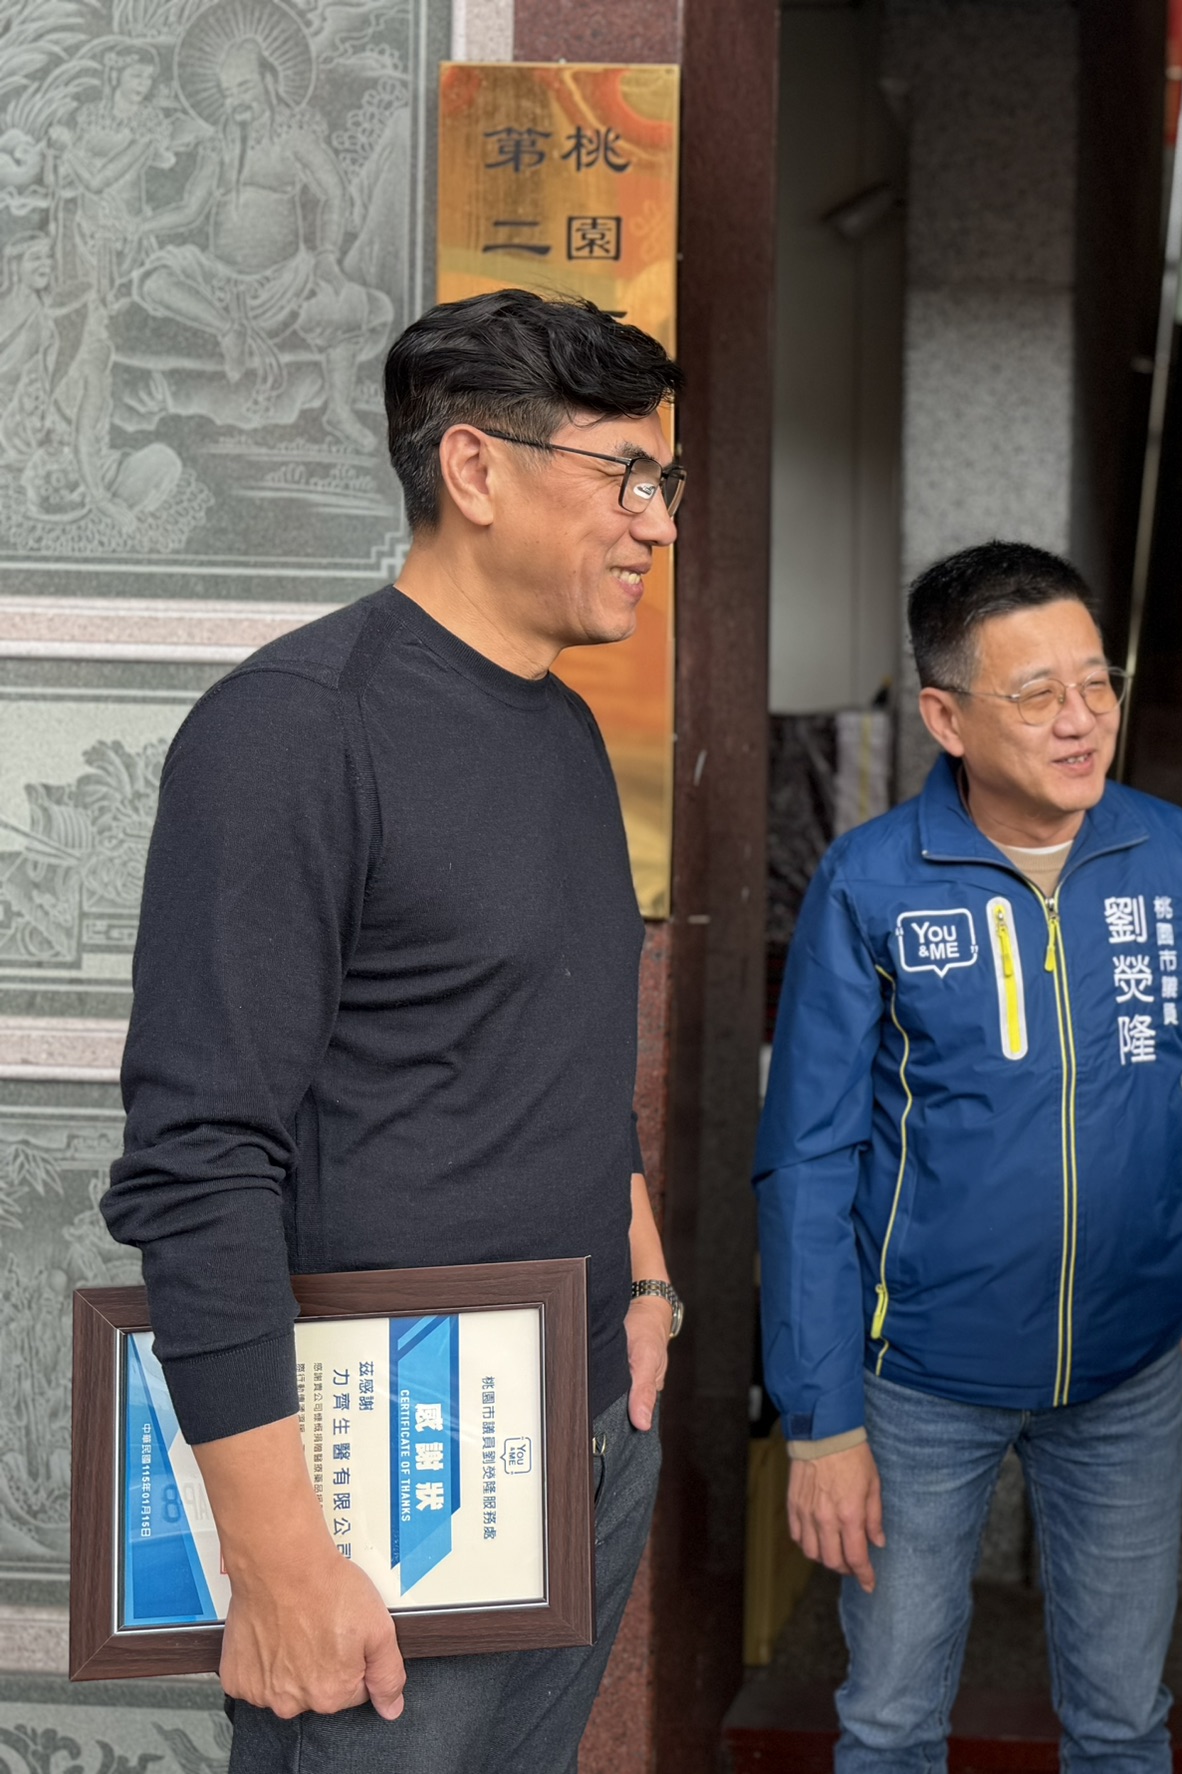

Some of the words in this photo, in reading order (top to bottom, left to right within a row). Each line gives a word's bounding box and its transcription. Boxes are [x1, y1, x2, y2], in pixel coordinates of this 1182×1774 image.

[483, 126, 551, 256] 第二
[911, 921, 957, 943] YOU
[918, 941, 960, 961] &ME
[1153, 896, 1179, 1026] 桃園市議員
[359, 1361, 374, 1411] 茲感謝
[400, 1389, 410, 1457] CERTIFICATE
[141, 1423, 152, 1537] 中華民國115年01月15日
[333, 1369, 352, 1559] 力齊生醫有限公司
[401, 1461, 411, 1475] OF
[415, 1403, 444, 1511] 感謝狀
[517, 1444, 527, 1466] YOU
[401, 1479, 411, 1522] THANKS
